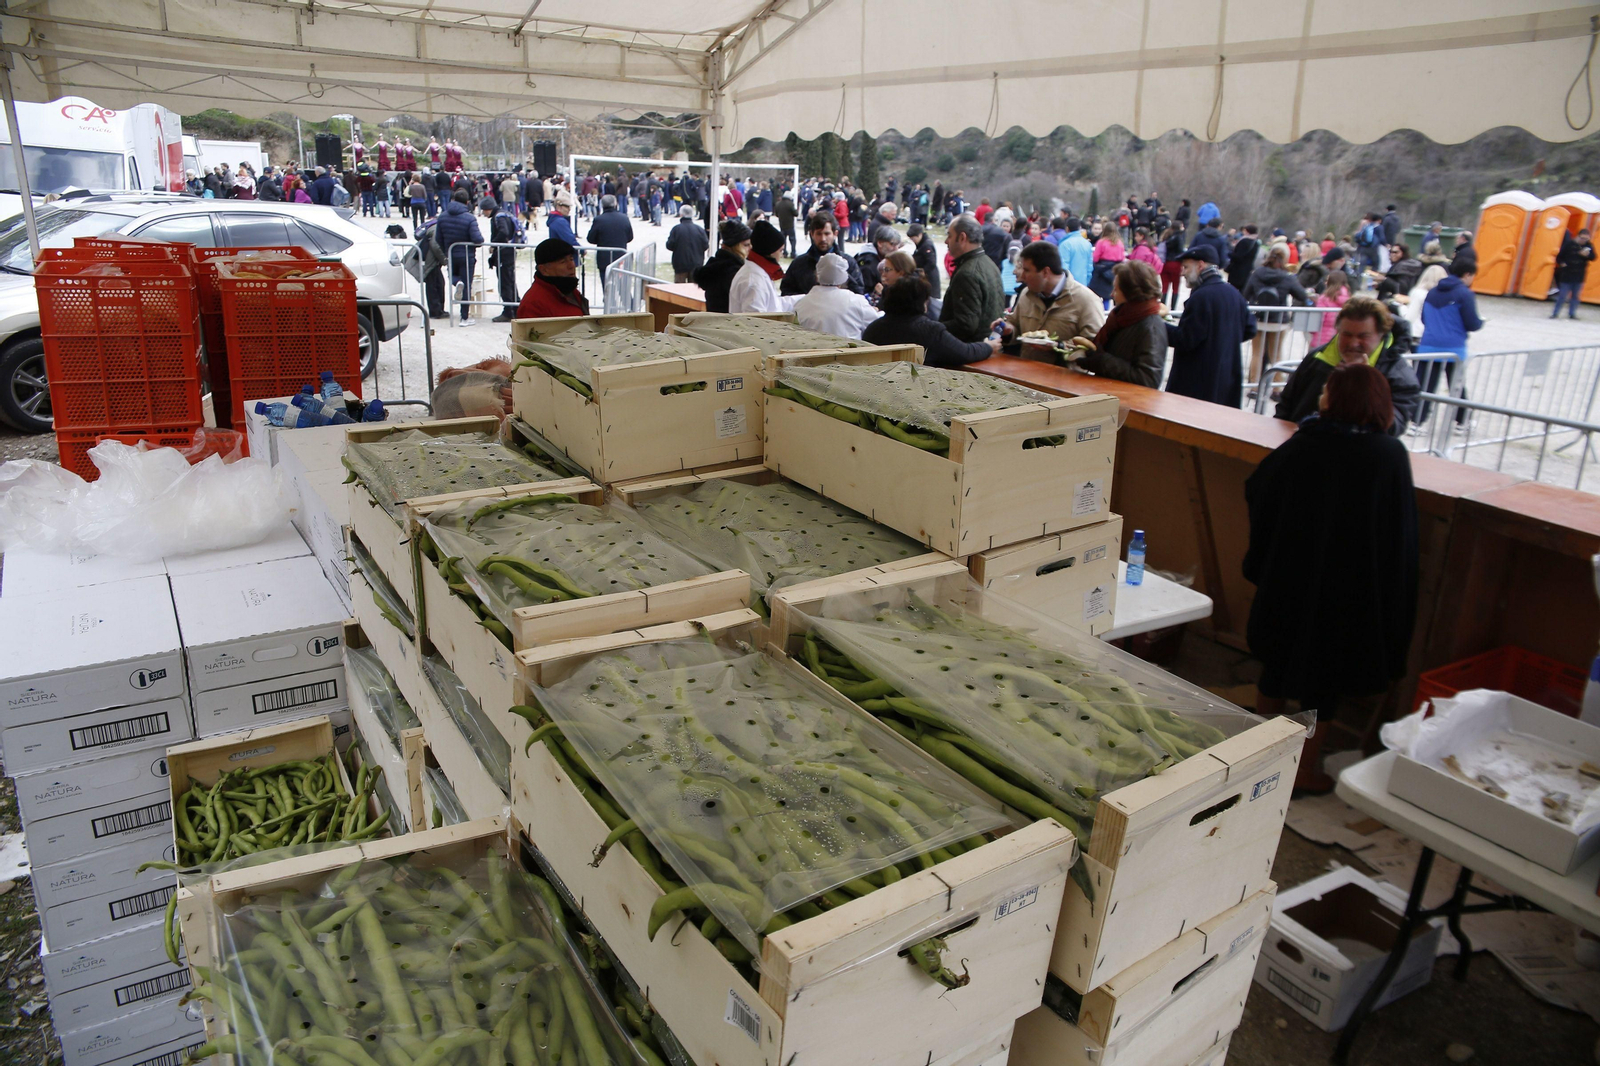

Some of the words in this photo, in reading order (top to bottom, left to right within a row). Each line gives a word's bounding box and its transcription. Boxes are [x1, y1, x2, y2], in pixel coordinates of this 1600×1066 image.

[204, 658, 246, 670] NATURA
[8, 692, 57, 706] NATURA
[34, 785, 82, 800] NATURA
[50, 873, 96, 888] NATURA
[61, 958, 106, 974] NATURA
[77, 1036, 122, 1053] NATURA
